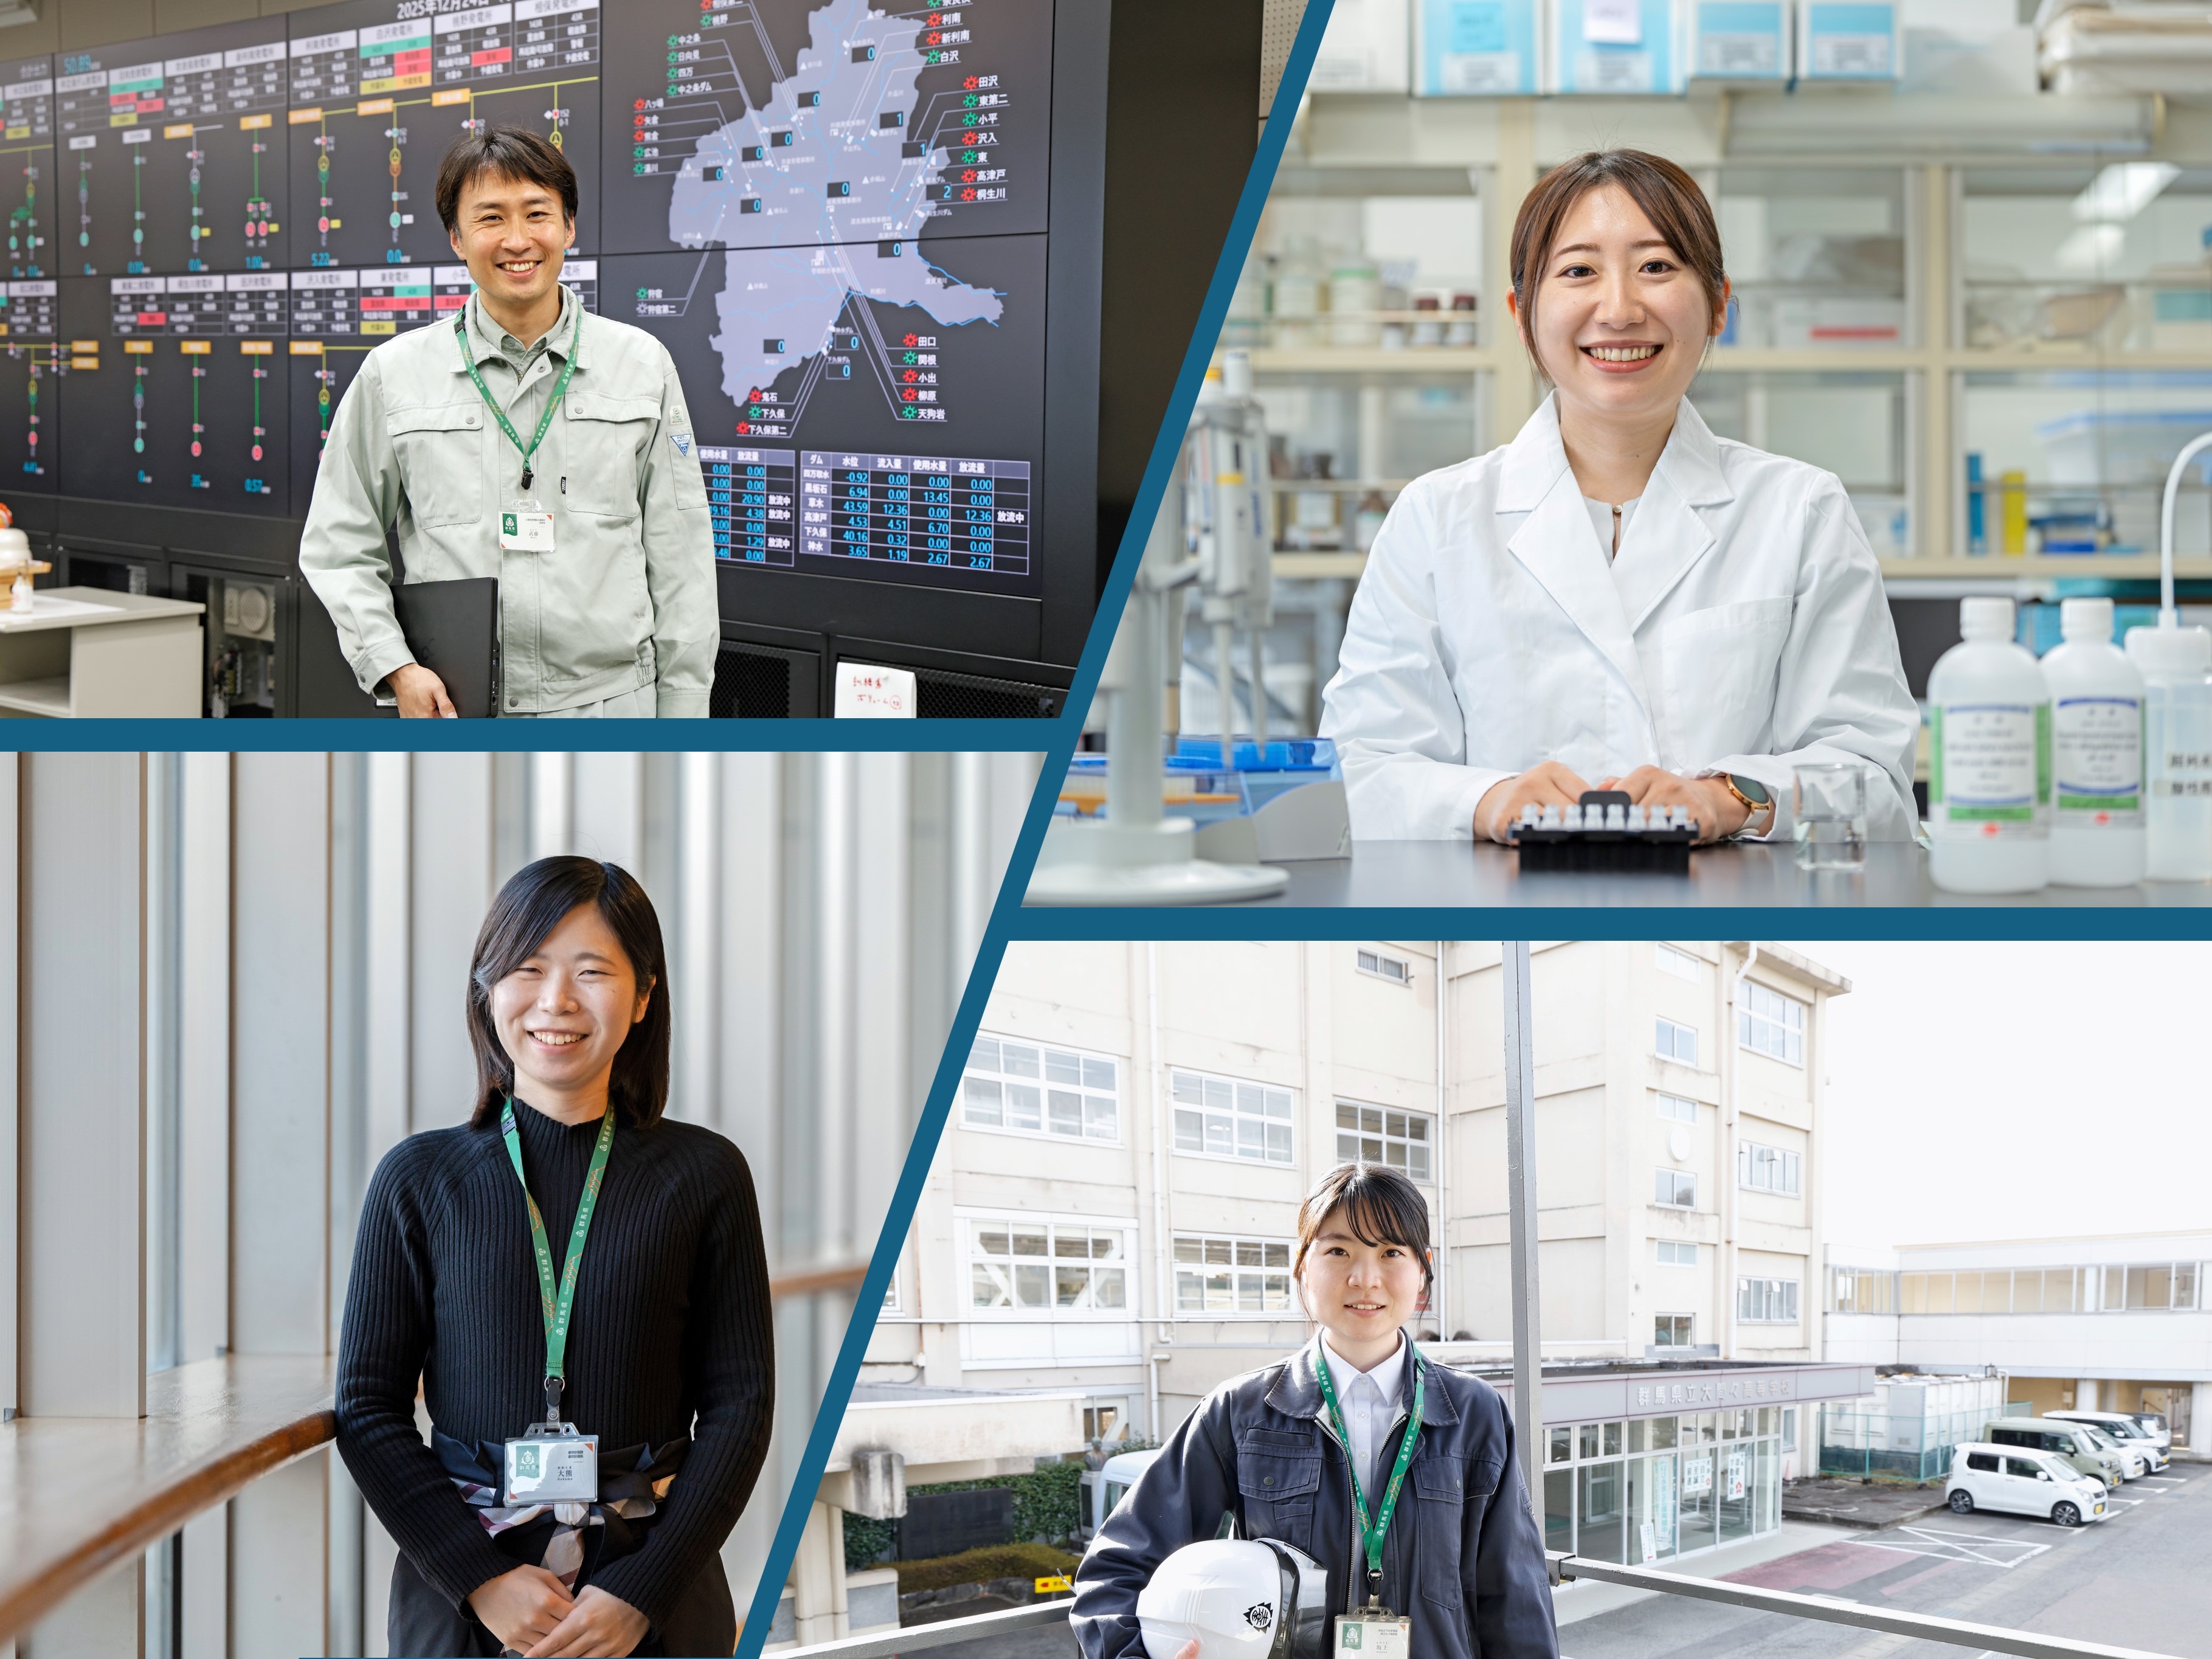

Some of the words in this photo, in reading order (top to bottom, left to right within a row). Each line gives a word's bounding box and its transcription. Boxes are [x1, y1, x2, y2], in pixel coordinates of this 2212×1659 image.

[942, 12, 961, 26] 利南
[941, 29, 970, 44] 新利南
[868, 47, 875, 60] 0
[940, 50, 959, 63] 白沢
[978, 75, 998, 88] 田沢
[813, 93, 820, 106] 0
[978, 93, 1009, 107] 東第二
[897, 113, 902, 126] 1
[978, 113, 998, 125] 小平
[784, 133, 792, 146] 0
[978, 132, 998, 145] 沢入
[756, 147, 763, 159] 0
[920, 143, 925, 156] 1
[978, 151, 988, 164] 東
[716, 168, 723, 181] 0
[976, 168, 1006, 182] 高津戸
[842, 182, 849, 195] 0
[944, 185, 952, 198] 2
[976, 187, 1006, 201] 桐生川
[753, 199, 761, 212] 0
[893, 243, 901, 256] 0
[778, 341, 784, 353] 0
[851, 336, 859, 348] 0
[918, 336, 936, 347] 田口
[918, 354, 936, 365] 関根
[843, 365, 851, 377] 0
[918, 372, 936, 383] 小出
[918, 408, 945, 420] 天狗岩
[700, 449, 728, 460] 使用水量
[737, 451, 759, 461] 放流量
[712, 463, 730, 475] 0.00
[747, 466, 764, 477] 0.00
[809, 454, 823, 465] ダム
[842, 456, 859, 467] 水位
[877, 457, 902, 469] 流入量
[913, 460, 947, 472] 使用水量
[959, 462, 986, 474] 放流量
[712, 478, 730, 489] 0.00
[747, 480, 764, 491] 0.00
[845, 472, 868, 483] -0.92
[888, 474, 908, 486] 0.00
[928, 476, 949, 488] 0.00
[970, 479, 992, 491] 0.00
[712, 491, 730, 502] 0.00
[742, 494, 764, 505] 20.90
[768, 494, 790, 505] 放流中
[848, 487, 868, 498] 6.94
[888, 489, 908, 500] 0.00
[924, 491, 949, 504] 13.45
[970, 494, 992, 506] 0.00
[746, 508, 764, 519] 4.38
[768, 508, 790, 520] 放流中
[808, 498, 824, 508] 草木
[843, 501, 868, 512] 43.59
[883, 504, 908, 516] 12.36
[928, 507, 949, 519] 0.00
[966, 510, 992, 522] 12.36
[997, 511, 1025, 523] 放流中
[746, 522, 764, 533] 0.00
[848, 516, 868, 527] 4.53
[887, 519, 907, 530] 4.51
[928, 522, 949, 534] 6.70
[970, 525, 992, 538] 0.00
[747, 536, 764, 547] 1.29
[767, 537, 790, 549] 放流中
[804, 526, 828, 538] 下久保
[843, 530, 868, 542] 40.16
[887, 533, 907, 545] 0.32
[928, 538, 949, 549] 0.00
[970, 541, 991, 553] 0.00
[746, 550, 764, 561] 0.00
[848, 545, 868, 557] 3.65
[888, 549, 907, 561] 1.19
[928, 552, 948, 565] 2.67
[970, 556, 991, 569] 2.67
[590, 1168, 599, 1188] Prefecture
[586, 1188, 595, 1202] Gunma
[578, 1207, 589, 1227] 群馬県
[542, 1259, 550, 1281] 群馬県
[558, 1302, 568, 1324] 群馬県
[1637, 1378, 1791, 1407] 群馬県立大間々高等学校
[1404, 1435, 1413, 1452] 群馬県
[1380, 1510, 1389, 1527] 群馬県
